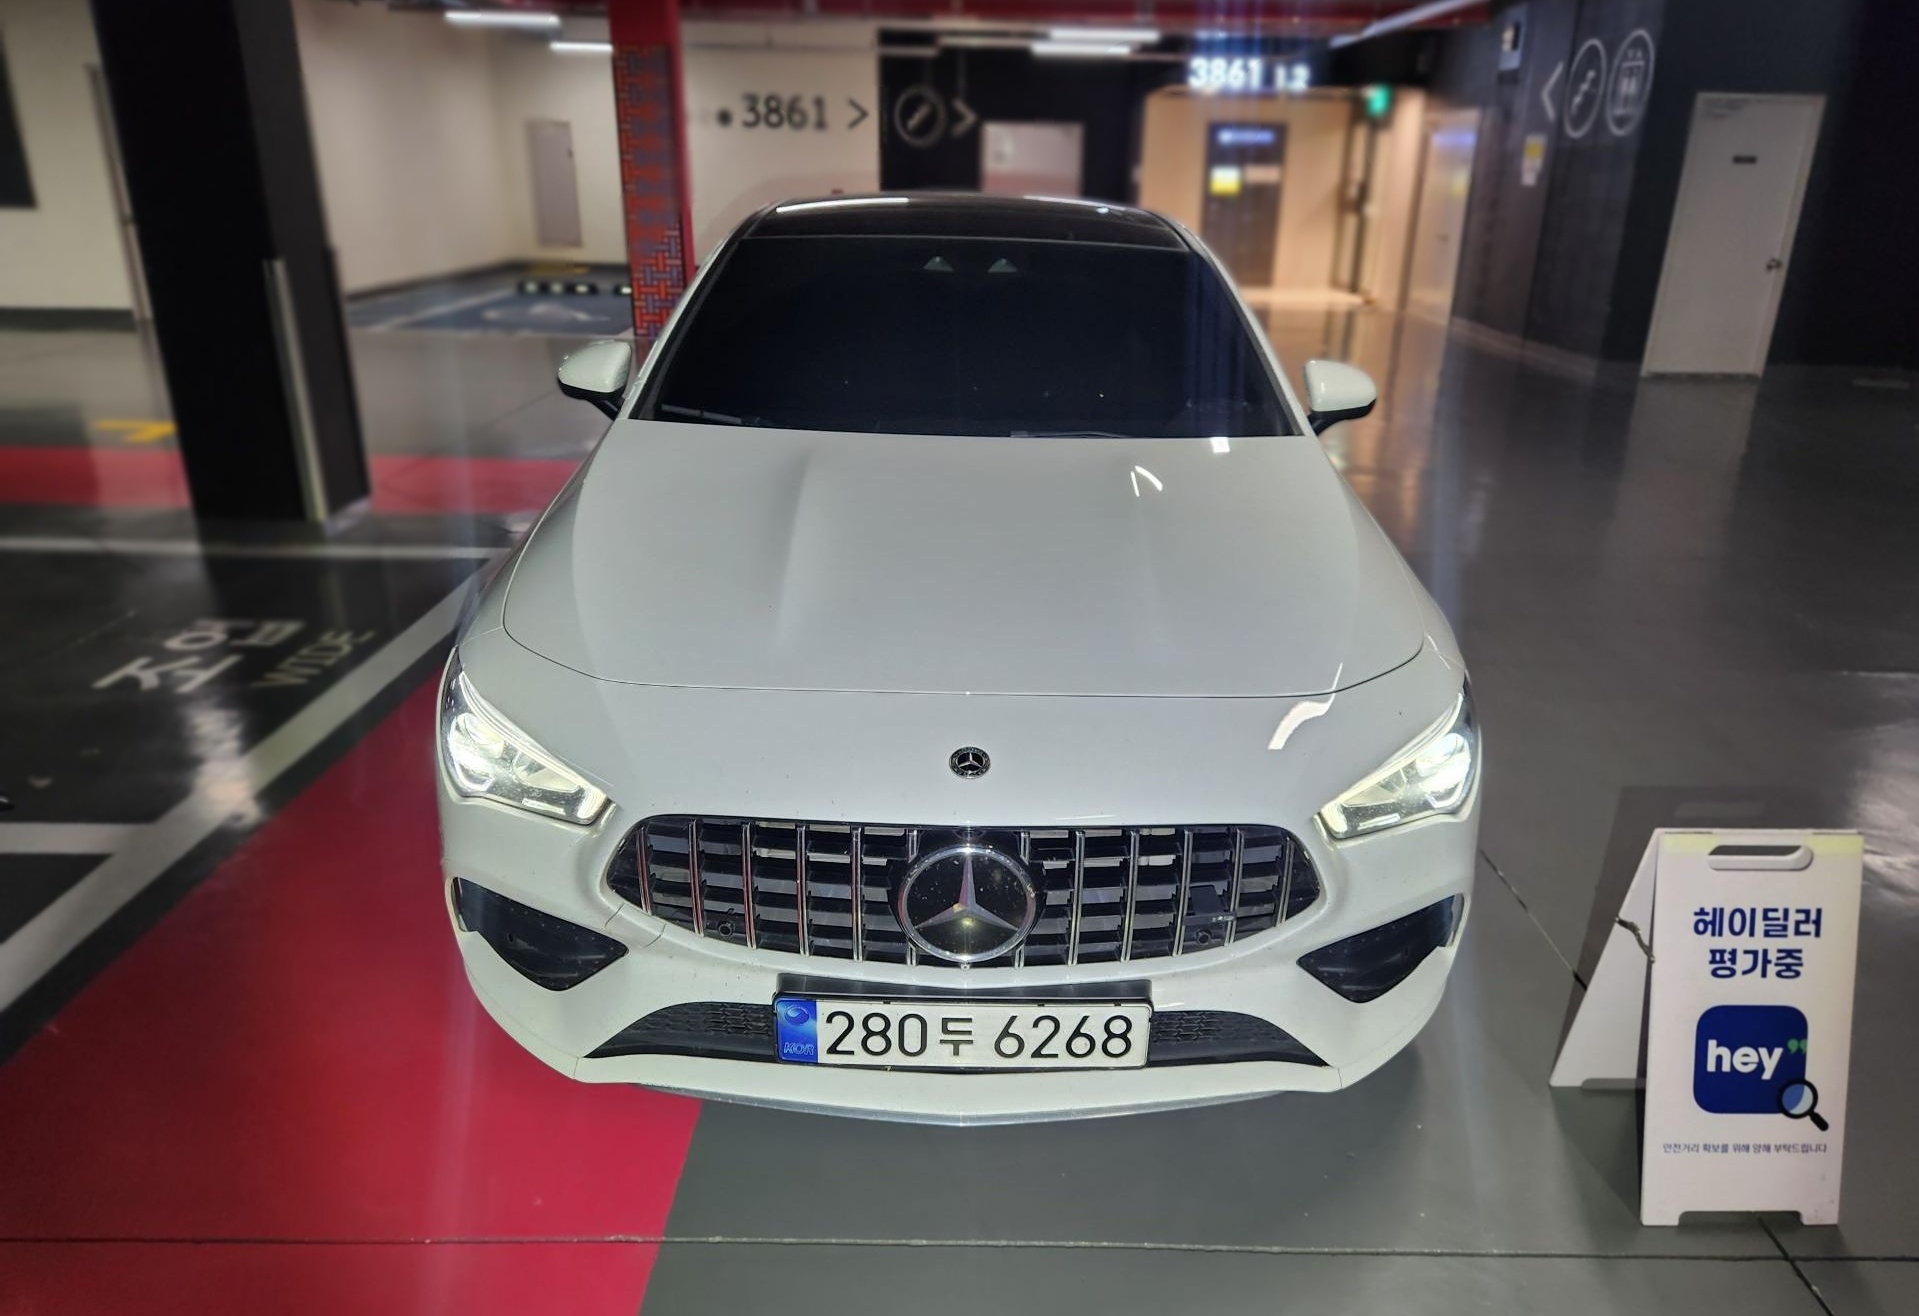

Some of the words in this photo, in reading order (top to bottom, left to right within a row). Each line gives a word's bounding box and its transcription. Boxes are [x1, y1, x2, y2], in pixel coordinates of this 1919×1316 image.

[1188, 56, 1262, 91] 3861
[741, 92, 827, 130] 3861
[250, 630, 375, 687] WIDE
[1693, 907, 1823, 938] 헤이딜러
[1708, 948, 1804, 979] 평가중
[783, 1041, 815, 1056] KOR
[825, 1010, 974, 1057] 280두
[994, 1014, 1133, 1059] 6268
[1663, 1143, 1700, 1154] 안전거리
[1703, 1143, 1729, 1154] 확보를
[1732, 1143, 1750, 1154] 위해
[1753, 1143, 1771, 1154] 양해
[1774, 1143, 1827, 1154] 부탁드립니다
